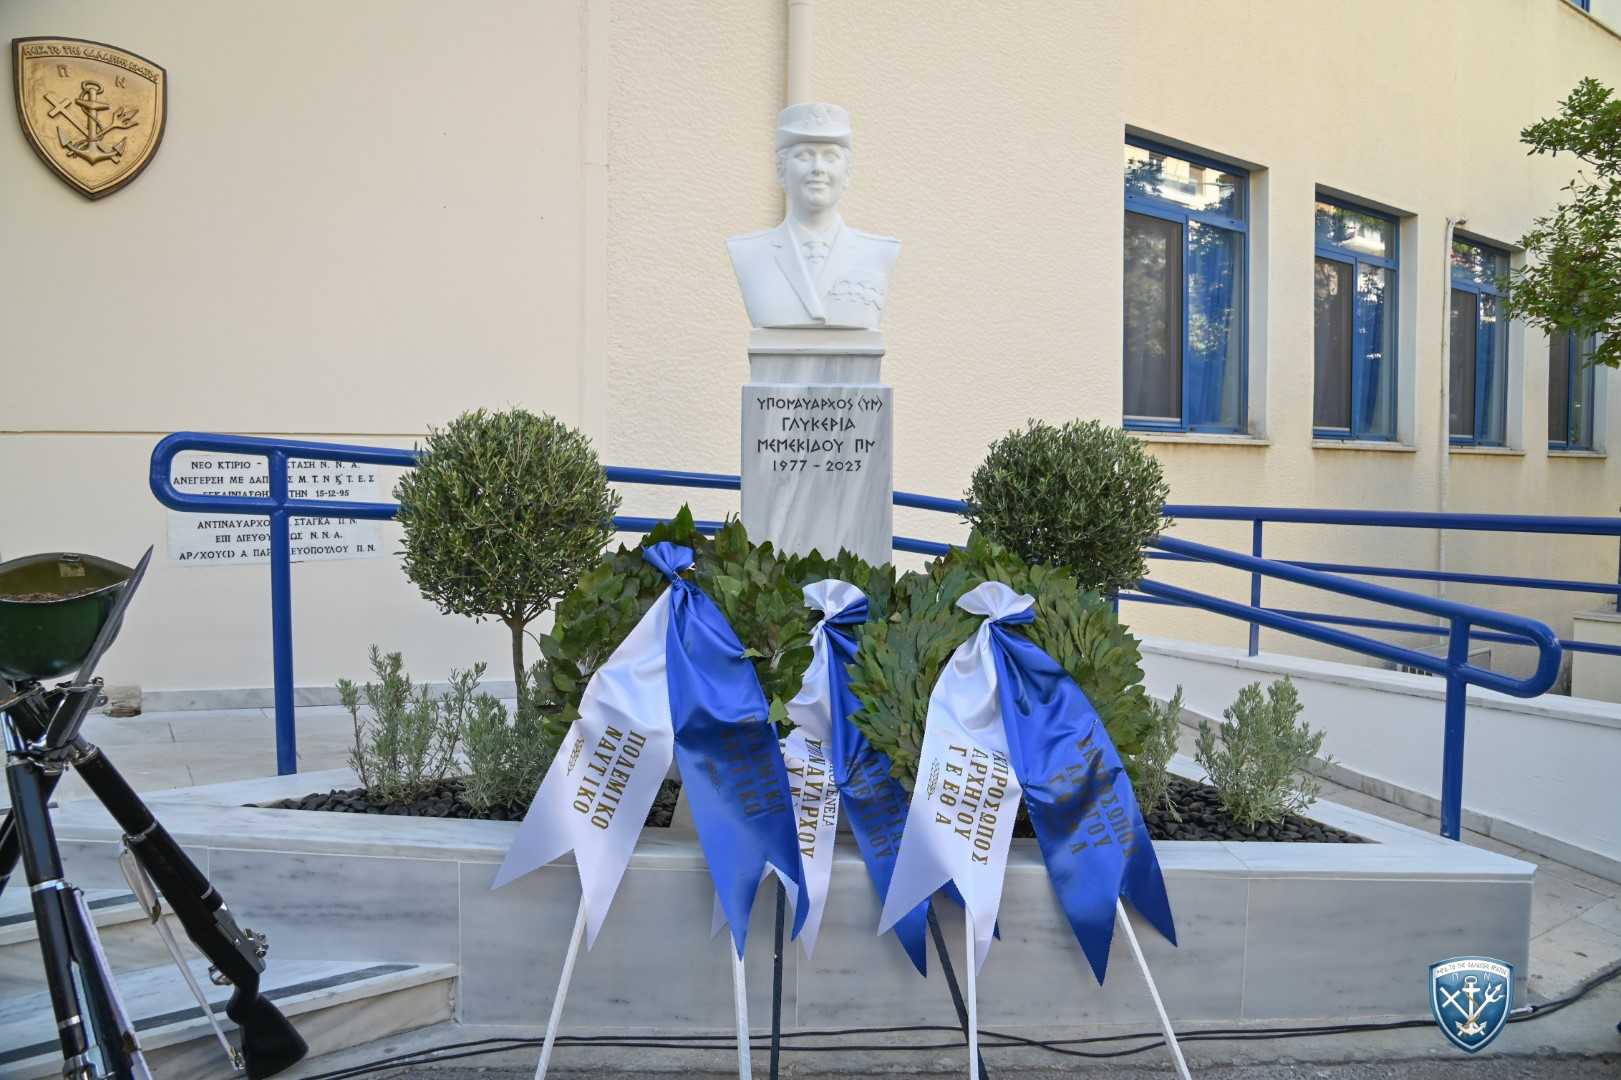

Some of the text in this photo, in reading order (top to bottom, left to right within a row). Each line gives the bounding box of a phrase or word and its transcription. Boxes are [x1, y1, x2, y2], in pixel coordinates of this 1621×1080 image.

[782, 416, 856, 431] ΓΛΥΚΕΡΙΑ
[757, 438, 844, 453] ΜΕΜΕΚΙΔΟΥ
[191, 461, 212, 469] ΝΕΟ
[218, 461, 251, 469] ΚΤΙΡΙΟ
[773, 460, 808, 472] 1977
[826, 459, 862, 472] 2023
[173, 476, 223, 485] ΑΝΕΓΕΡΣΗ
[229, 476, 244, 484] ΜΕ
[316, 489, 350, 498] 15-12-95
[197, 519, 271, 529] ΑΝΤΙΝΑΥΑΡΧΟ
[573, 725, 623, 813] ΝΑΥΤΙΚΟ
[591, 730, 647, 829] ΠΟΛΕΜΙΚΟ
[955, 746, 989, 841] ΑΡΧΗΓΟΥ
